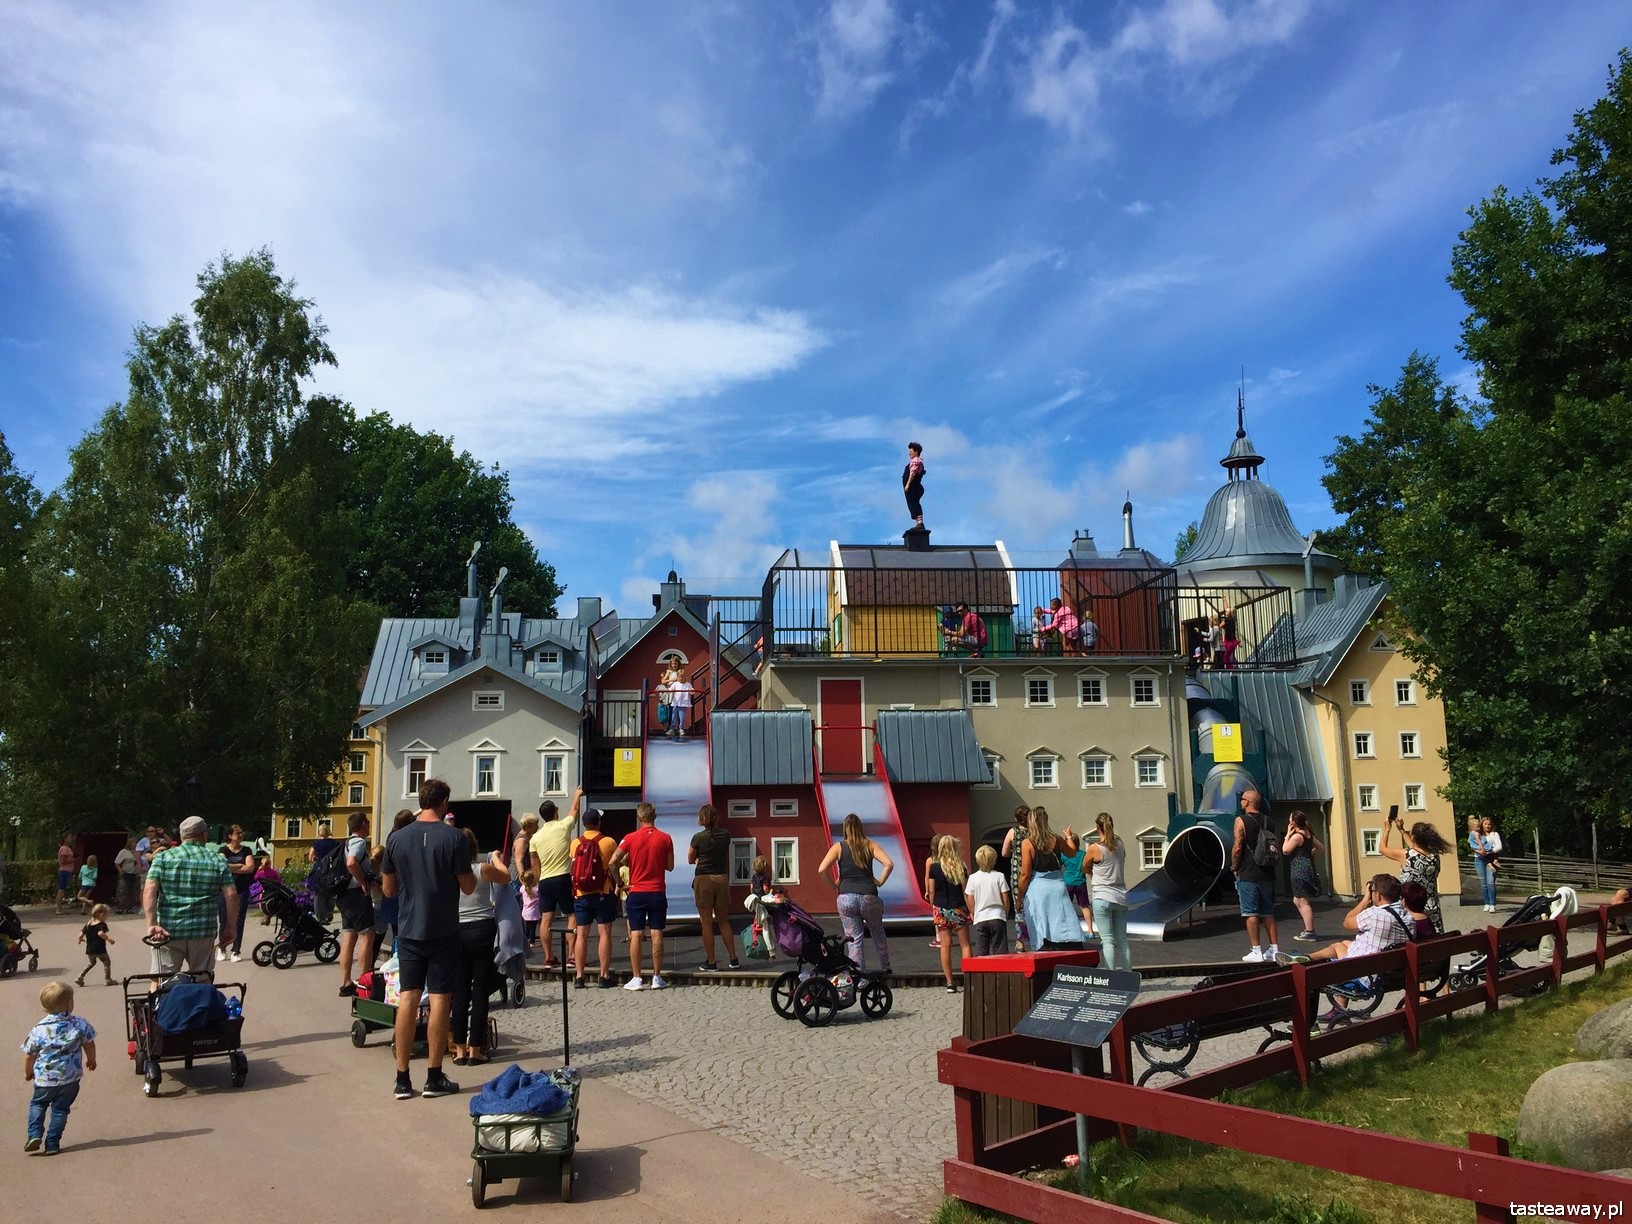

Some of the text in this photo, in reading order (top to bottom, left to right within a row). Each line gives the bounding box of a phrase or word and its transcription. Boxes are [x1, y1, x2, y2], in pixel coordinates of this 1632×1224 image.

[1056, 972, 1110, 986] Karlsson på taket
